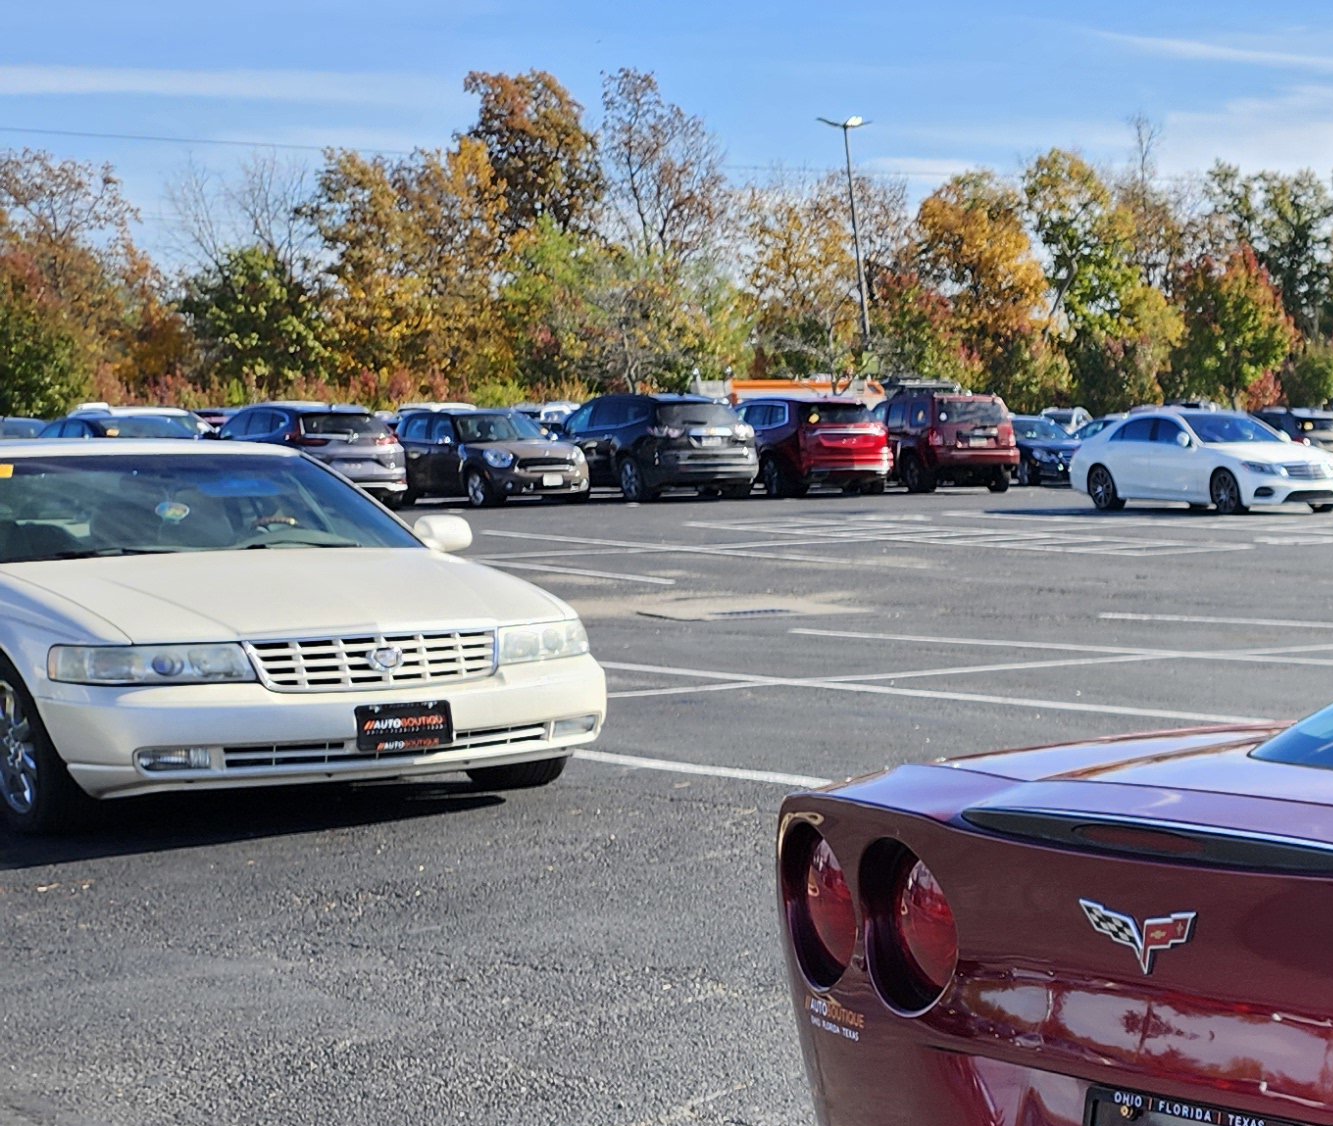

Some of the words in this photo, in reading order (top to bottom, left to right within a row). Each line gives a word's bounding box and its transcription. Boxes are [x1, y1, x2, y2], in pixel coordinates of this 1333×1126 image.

[810, 998, 864, 1029] AUTOBOUTIQUE
[842, 1027, 859, 1041] TEXAS
[1114, 1091, 1142, 1107] OHIO
[1158, 1100, 1212, 1122] FLORIDA
